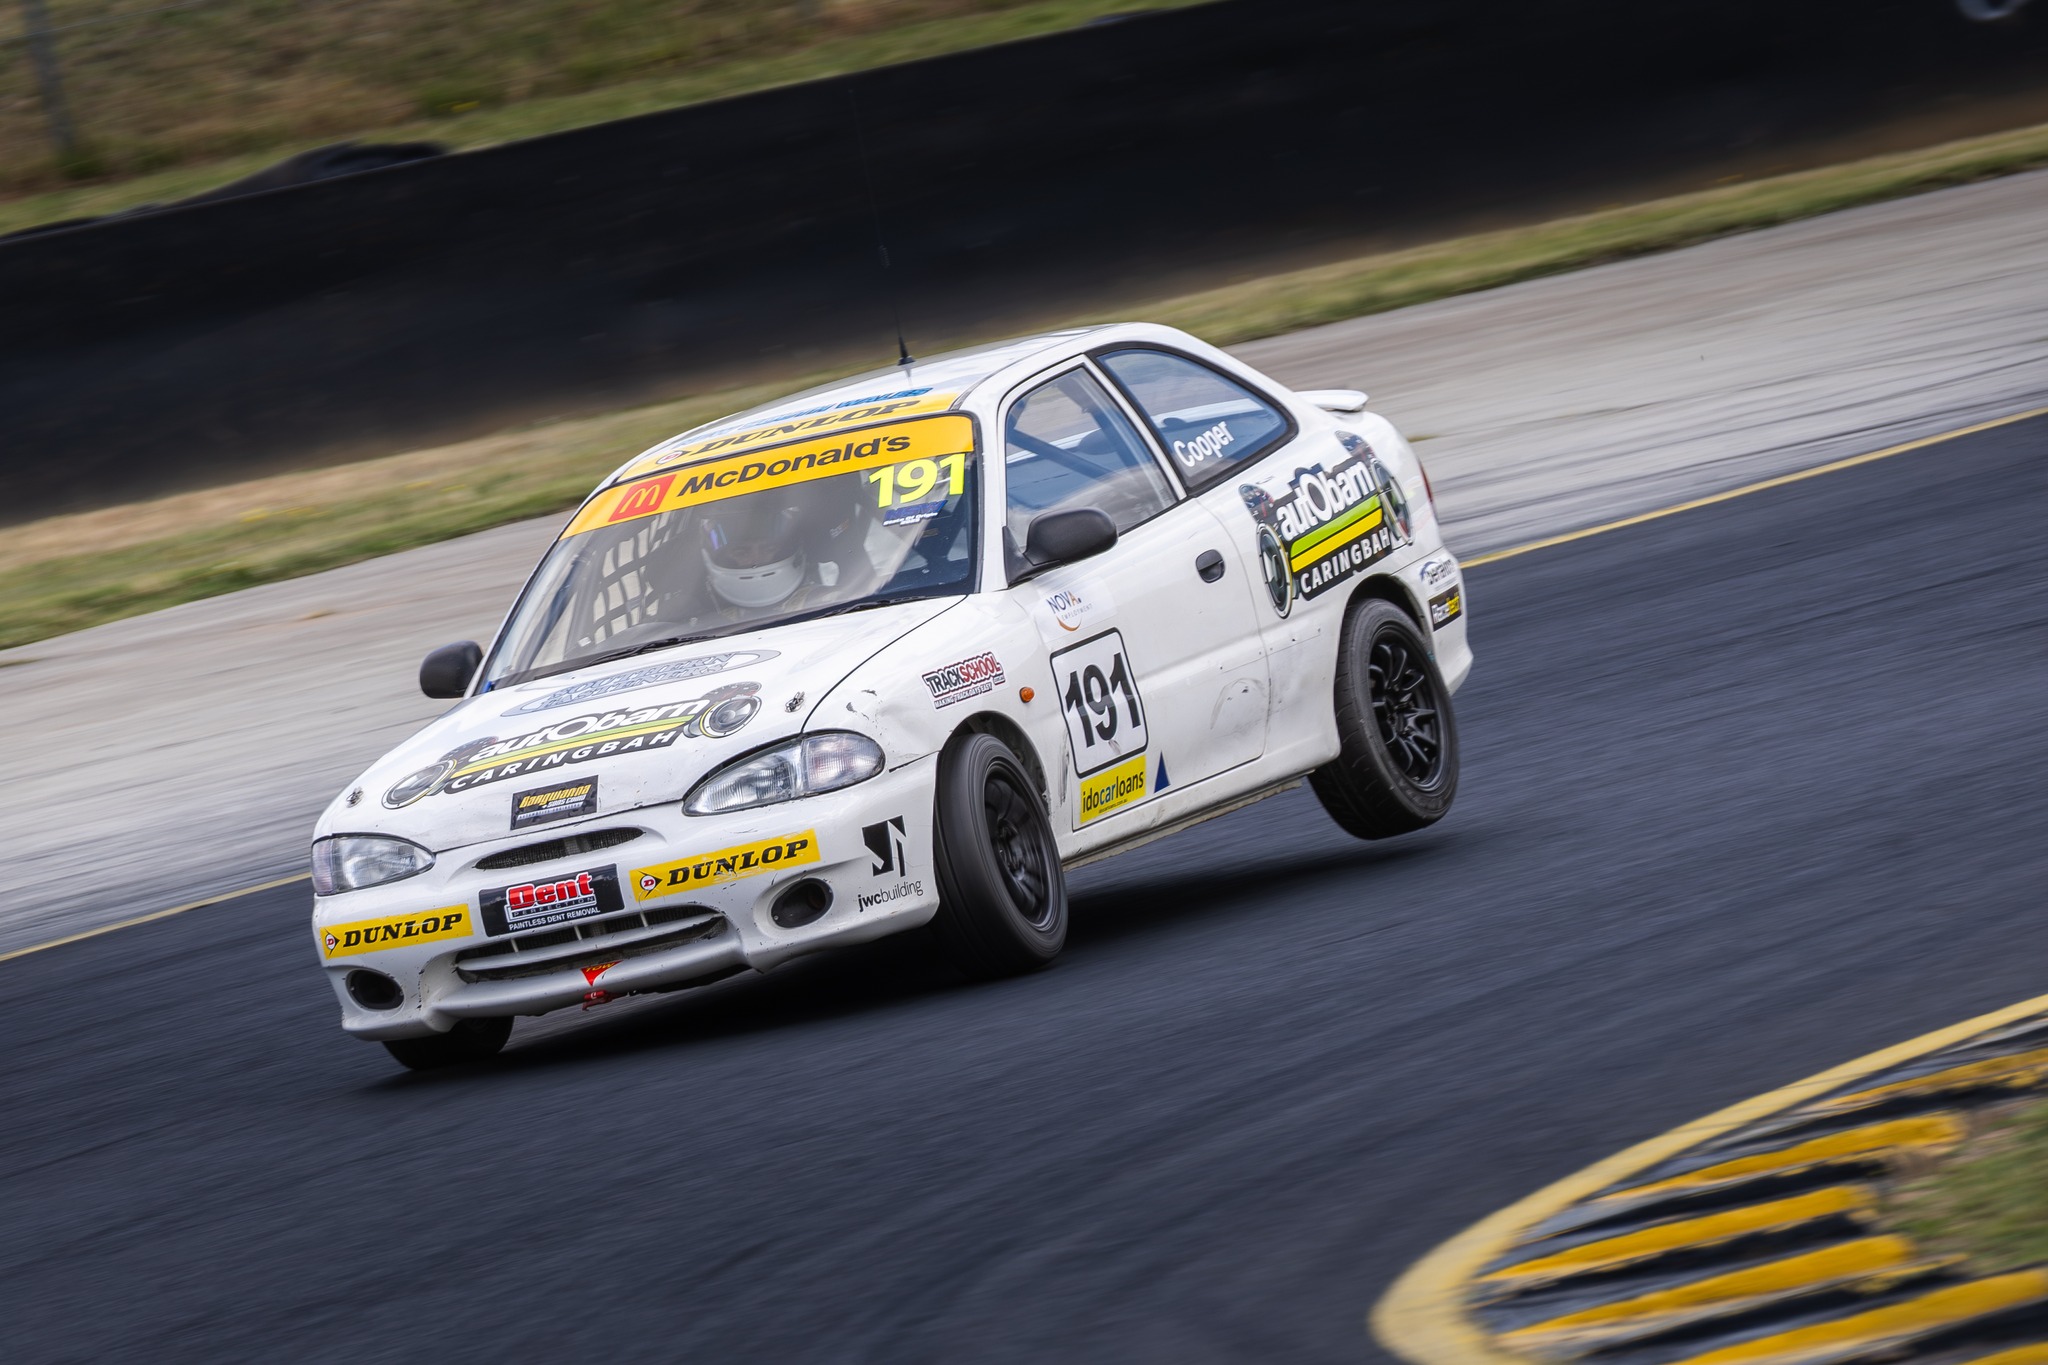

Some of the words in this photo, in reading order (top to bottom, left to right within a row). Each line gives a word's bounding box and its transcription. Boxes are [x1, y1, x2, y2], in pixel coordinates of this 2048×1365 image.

[690, 400, 922, 456] DUNLOP
[1173, 420, 1235, 468] Cooper
[677, 435, 911, 497] McDonald's
[869, 453, 965, 509] 191
[1301, 527, 1391, 594] CARINGBAH
[924, 655, 1001, 695] TRACKSCHOOL
[1065, 652, 1142, 748] 191
[451, 733, 677, 790] CARINGBAH
[1083, 771, 1144, 813] idocarloans
[667, 839, 808, 887] DUNLOP
[507, 872, 594, 909] Dent
[513, 897, 594, 917] PERFECTION
[858, 880, 924, 913] jwcbuilding
[343, 913, 463, 948] DUNLOP
[508, 918, 547, 931] PAINTLESS
[547, 913, 566, 923] DENT
[566, 907, 601, 919] REMOVAL
